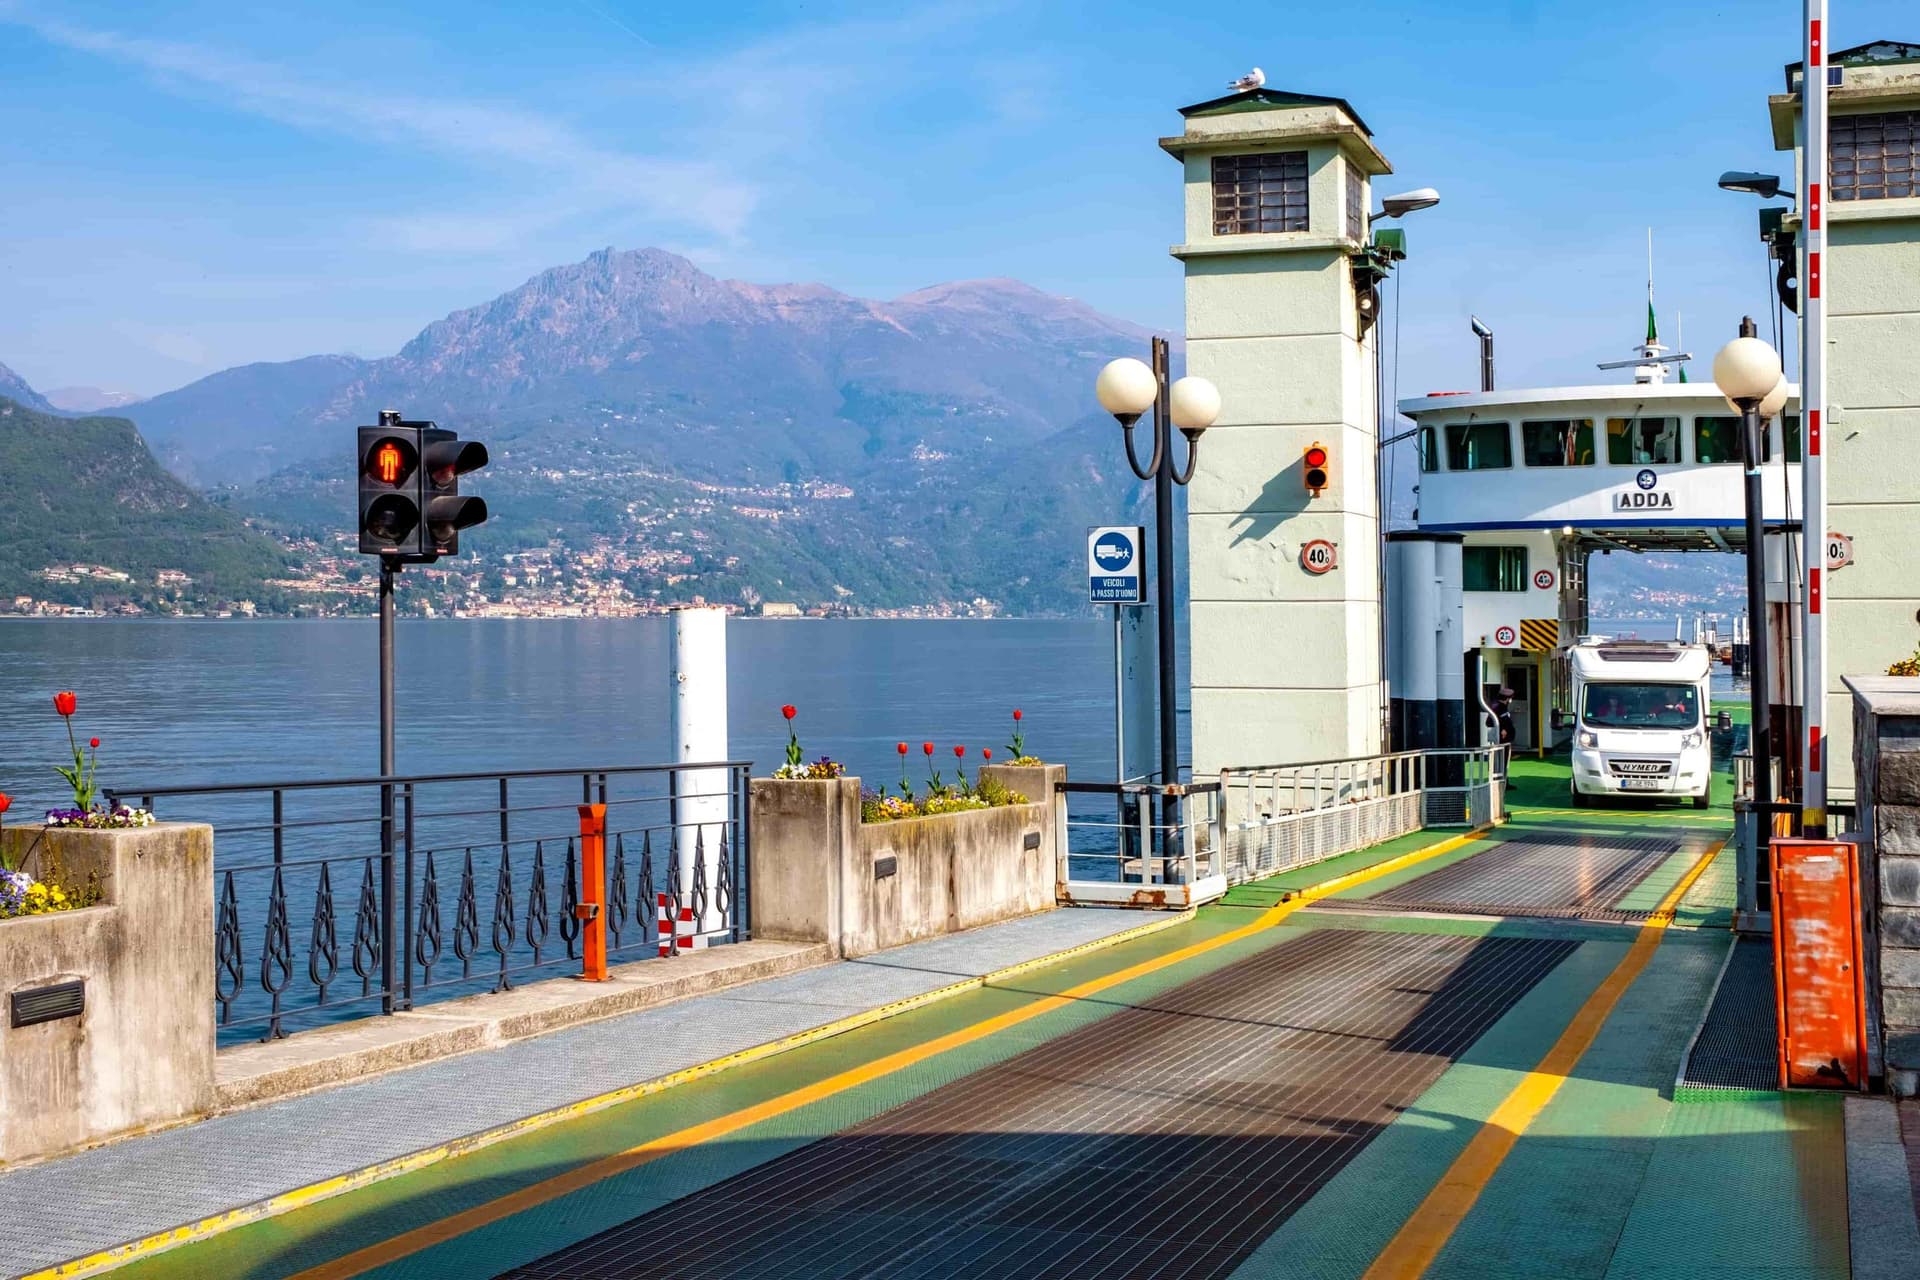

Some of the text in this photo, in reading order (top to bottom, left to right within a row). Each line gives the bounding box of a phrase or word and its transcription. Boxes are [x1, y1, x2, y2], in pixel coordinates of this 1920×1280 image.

[1620, 492, 1672, 507] ADDA
[1103, 579, 1125, 587] VEICOLI
[1097, 590, 1115, 598] PASSO
[1115, 590, 1136, 598] D'UOMO
